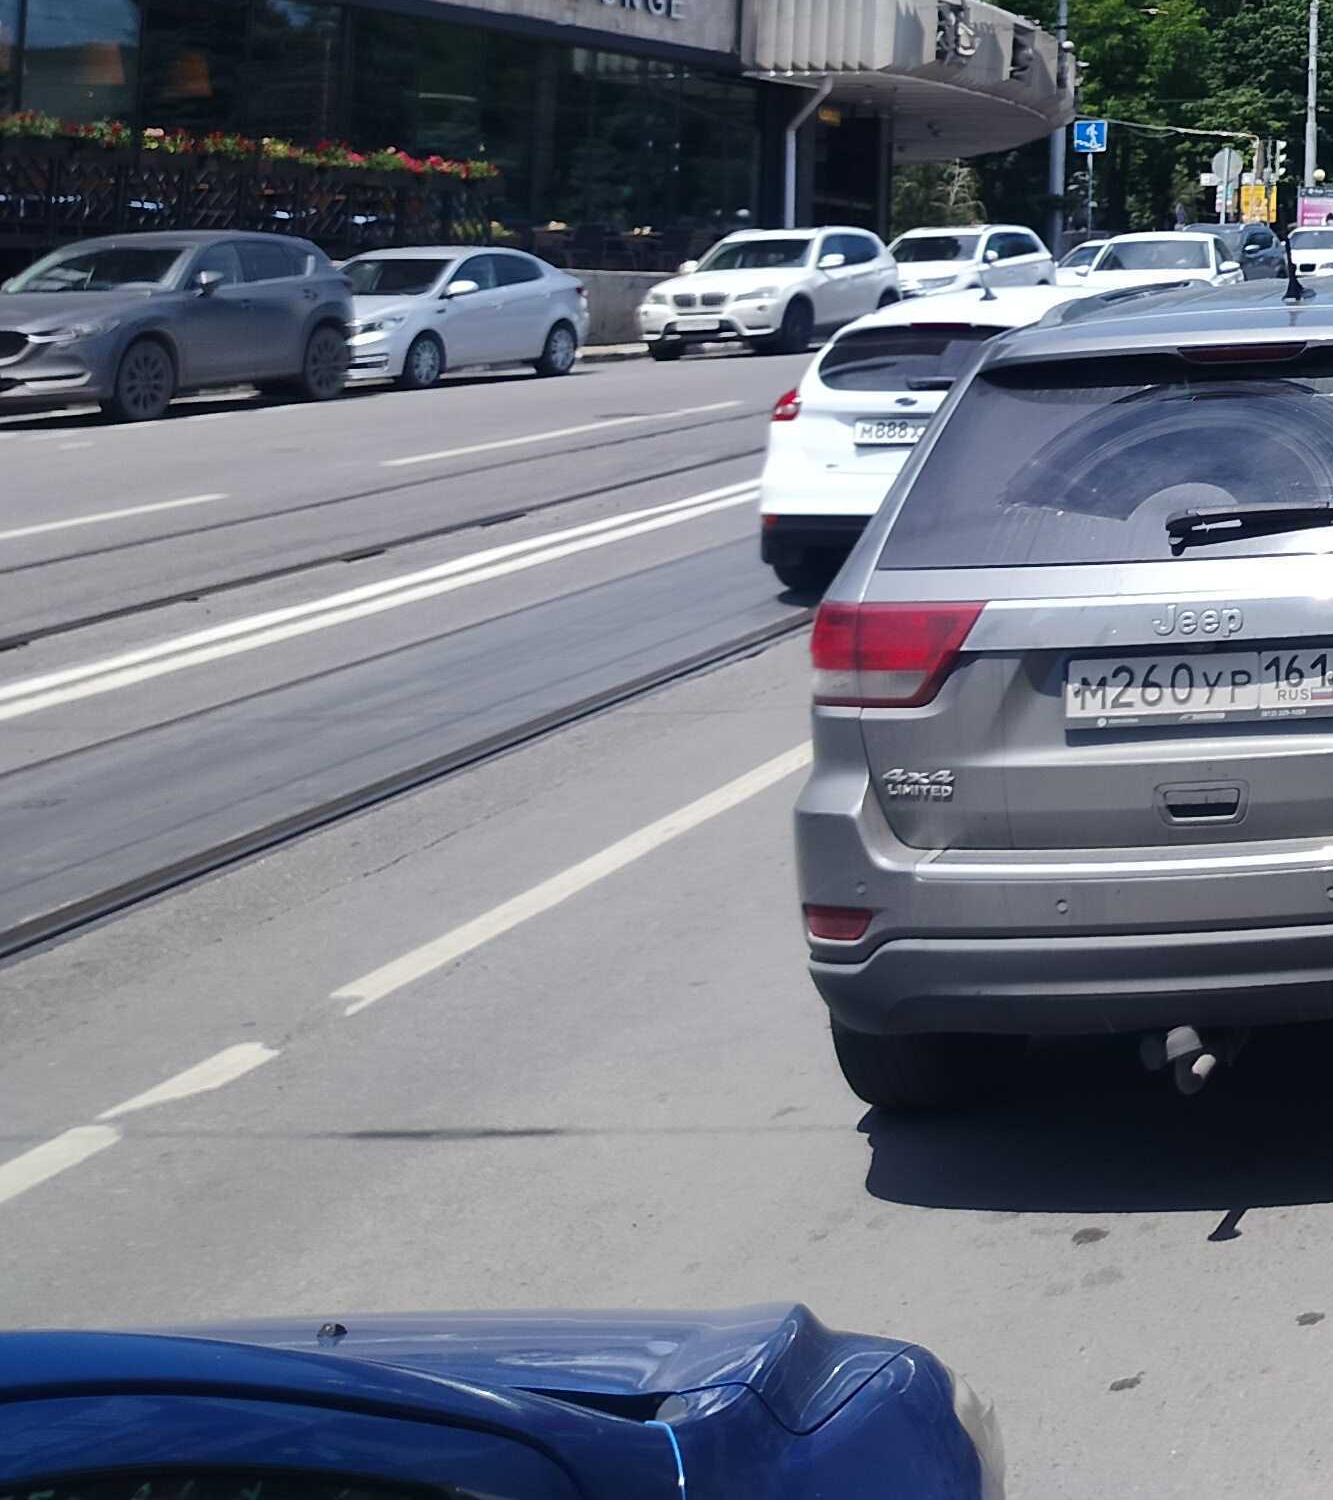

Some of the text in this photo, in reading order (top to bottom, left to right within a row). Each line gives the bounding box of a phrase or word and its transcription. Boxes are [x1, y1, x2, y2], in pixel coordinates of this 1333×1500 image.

[1152, 604, 1244, 637] Jeep
[1264, 653, 1328, 688] 161
[1277, 688, 1309, 702] RUS
[887, 784, 953, 797] LIMITED
